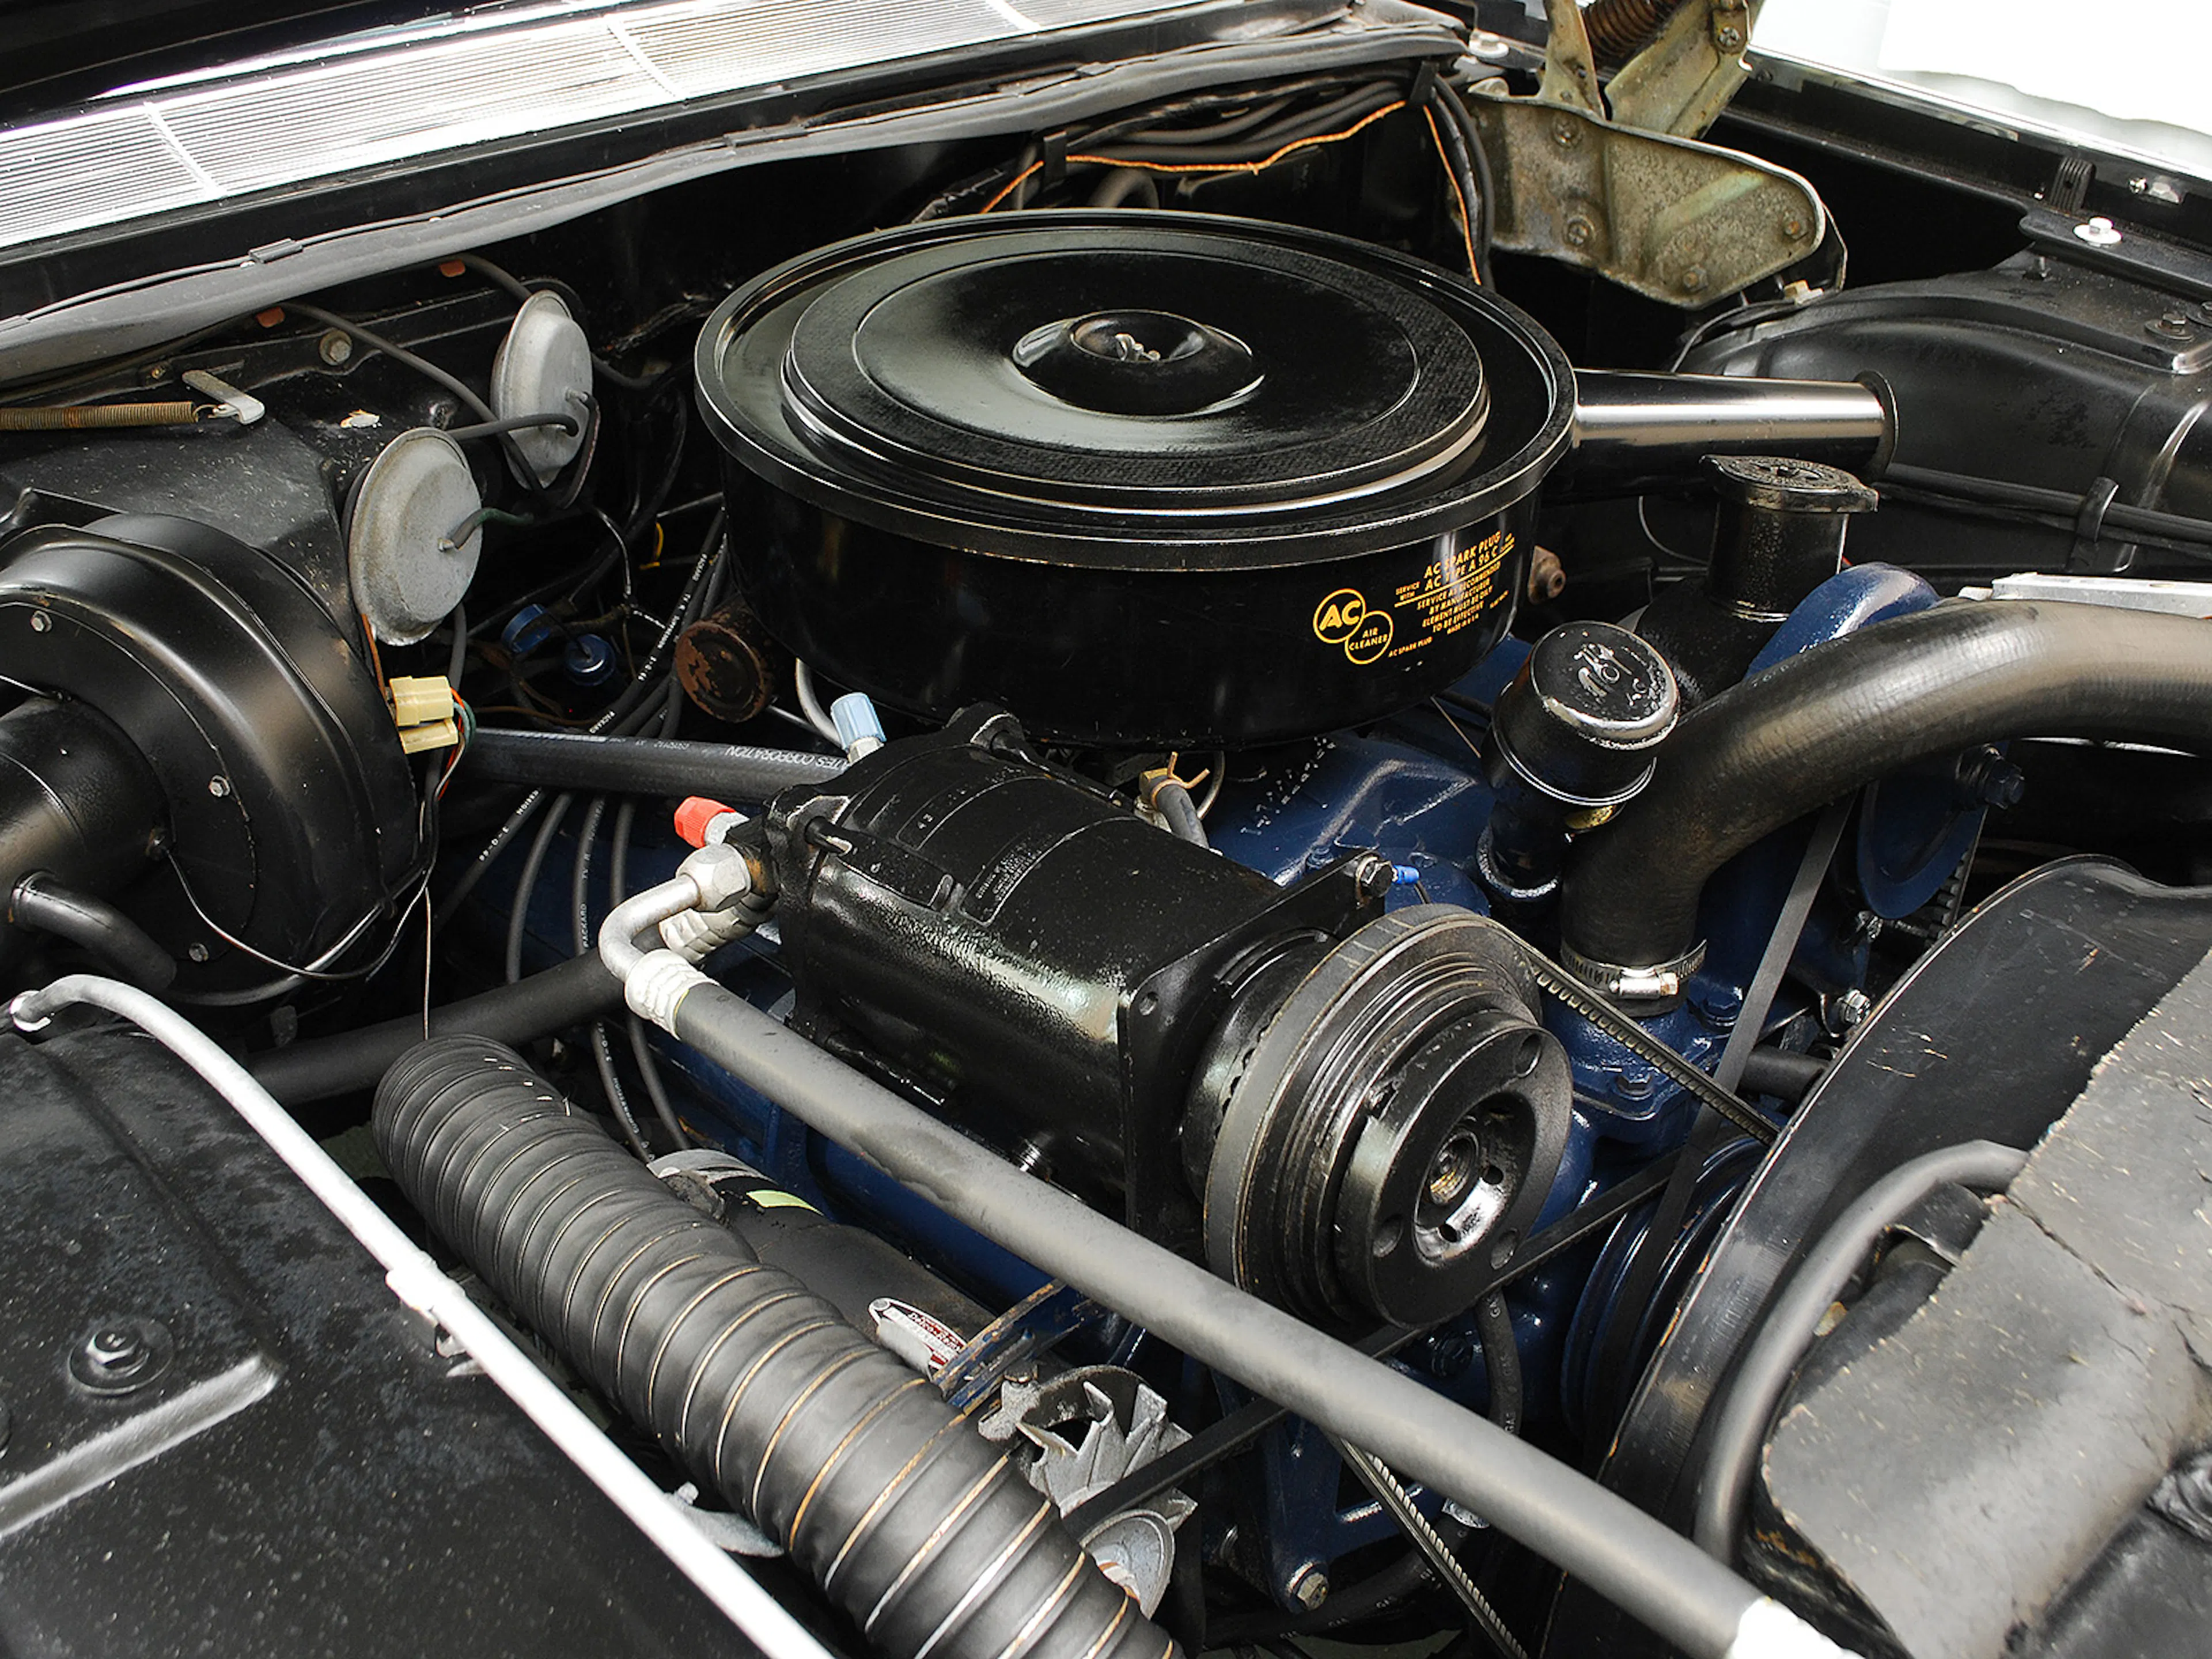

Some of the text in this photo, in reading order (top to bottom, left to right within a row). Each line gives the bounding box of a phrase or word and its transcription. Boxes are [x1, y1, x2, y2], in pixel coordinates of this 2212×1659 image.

[1423, 561, 1442, 578] AC
[1444, 545, 1477, 571] SPARK
[1479, 530, 1501, 554] PLUG
[1425, 574, 1442, 591] AC
[1445, 565, 1466, 582] TYPE
[1468, 559, 1476, 571] A
[1491, 546, 1498, 558] C
[1396, 581, 1421, 595] SERVICE
[1417, 590, 1447, 611] SERVICE
[1429, 604, 1440, 615] BY
[1319, 600, 1361, 631] AC
[1422, 607, 1453, 627] ELEMENT
[1433, 623, 1442, 632] TO
[1443, 618, 1452, 628] BE
[1349, 634, 1388, 650] CLEANER
[1362, 627, 1378, 638] AIR
[1388, 649, 1398, 657] AC
[725, 745, 850, 770] ATES CORPORATION
[579, 903, 589, 948] PACKARD
